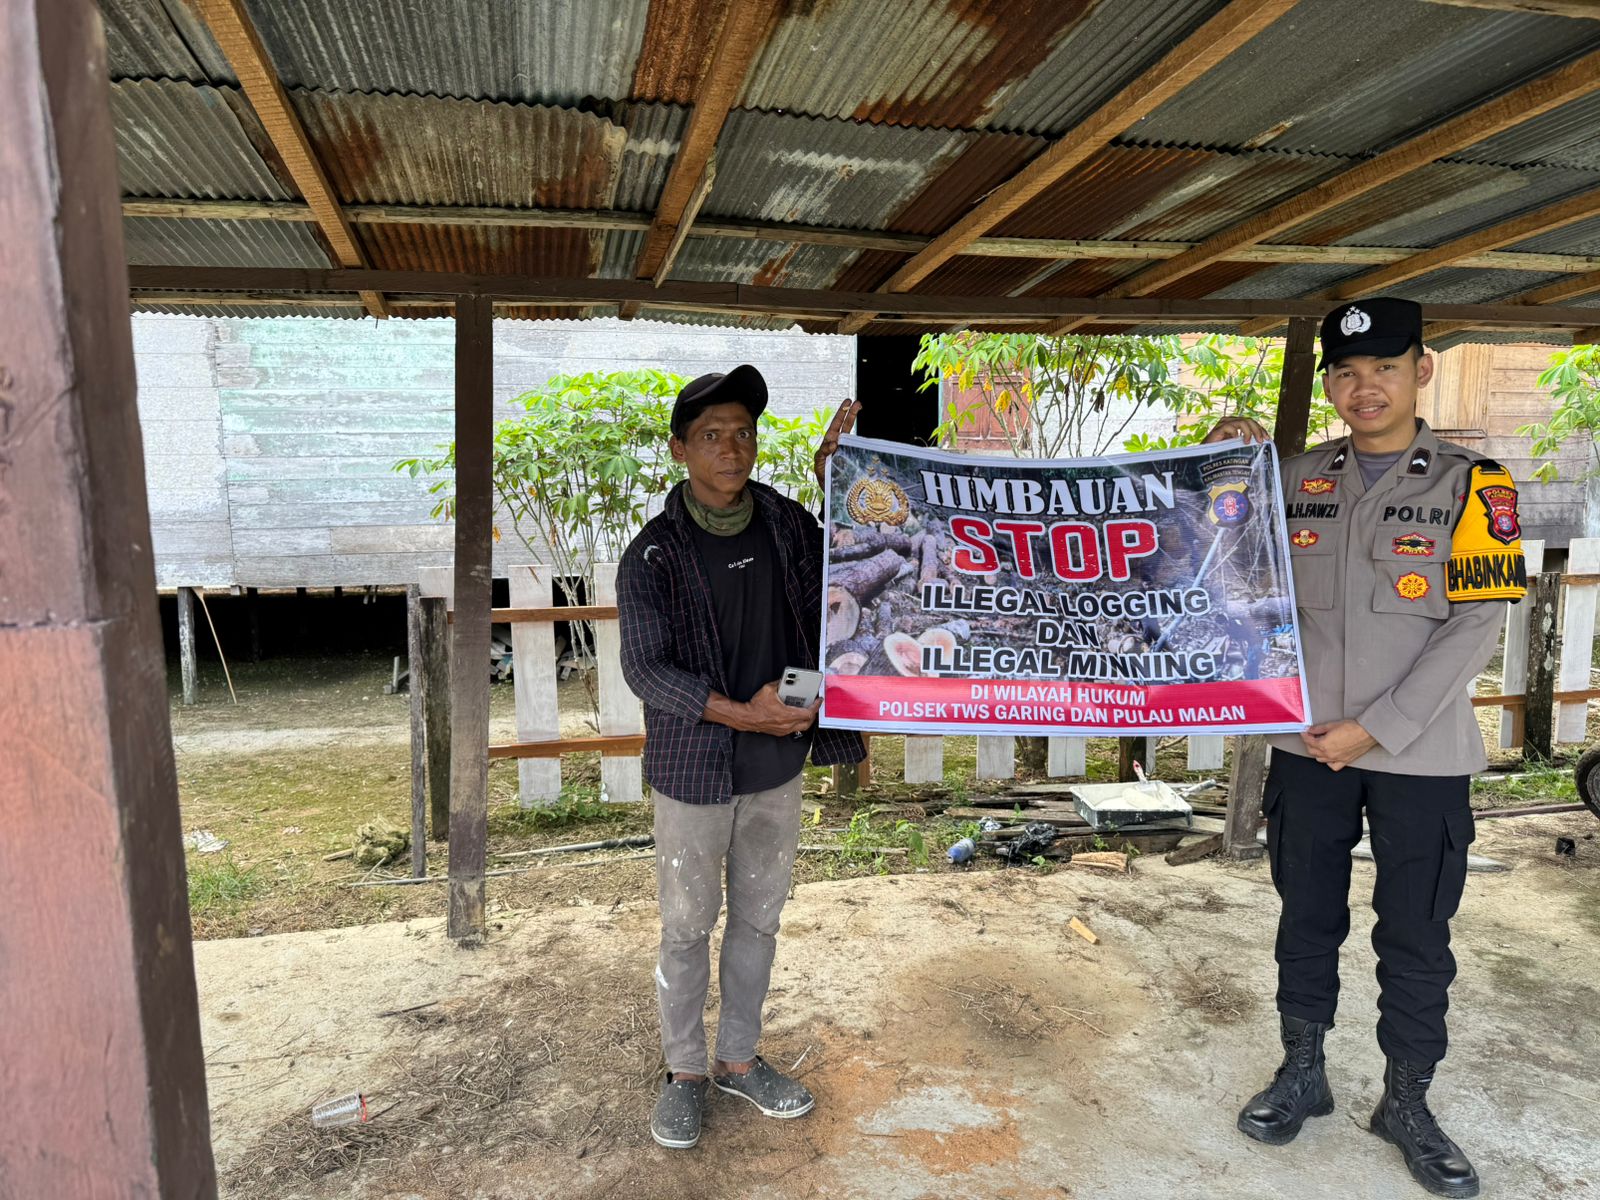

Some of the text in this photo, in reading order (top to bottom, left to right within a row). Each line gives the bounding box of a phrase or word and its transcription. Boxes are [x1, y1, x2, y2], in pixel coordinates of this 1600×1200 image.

[920, 470, 1176, 516] HIMBAUAN
[1383, 505, 1451, 526] POLRI
[950, 515, 1159, 582] STOP
[921, 584, 1209, 620] ILLEGAL LOGGING
[1036, 619, 1099, 648] DAN
[920, 647, 1216, 681] ILLEGAL MINNING
[971, 684, 1146, 706] DI WILAYAH HUKUM
[879, 701, 1246, 723] POLSEK TWS GARING DAN PULAU MALAN
